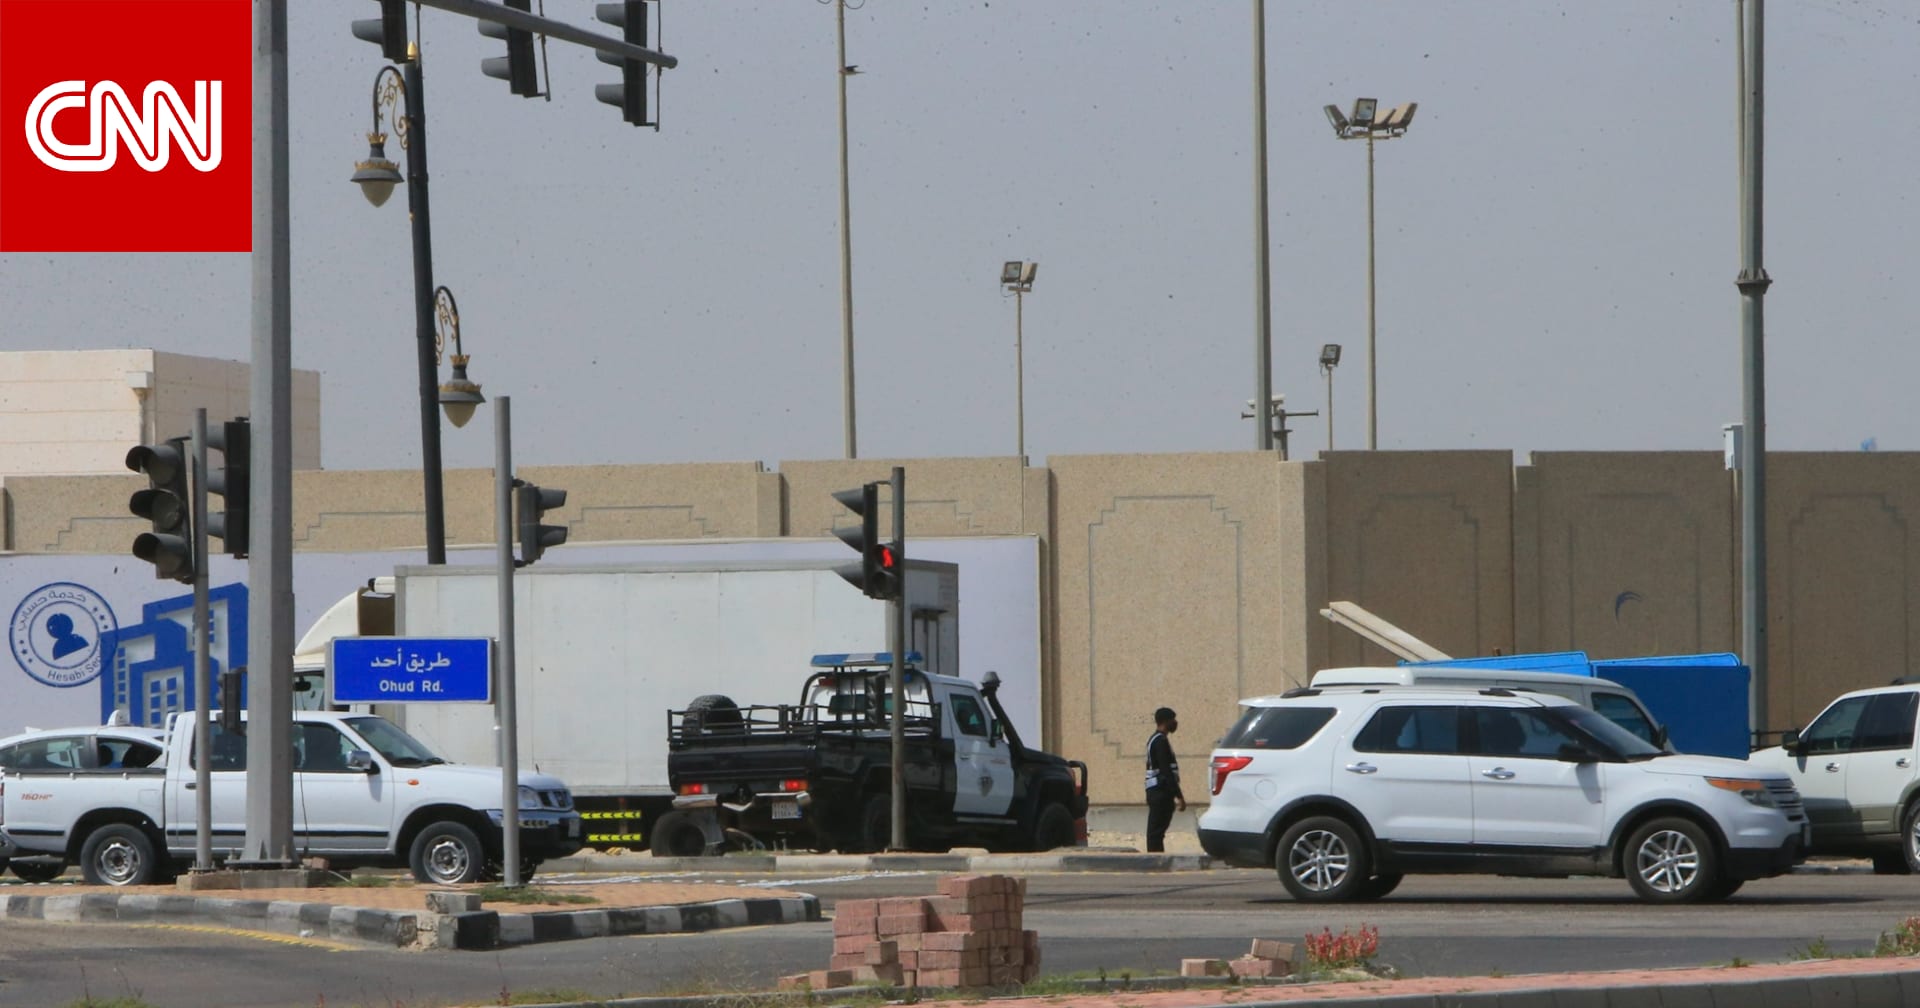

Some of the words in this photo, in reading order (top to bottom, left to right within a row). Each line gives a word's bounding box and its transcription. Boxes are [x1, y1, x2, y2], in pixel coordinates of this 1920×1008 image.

[370, 648, 402, 667] أحد
[406, 652, 451, 672] طريق
[47, 669, 85, 682] Hesabi
[379, 680, 414, 692] Ohud
[422, 680, 444, 692] Rd.
